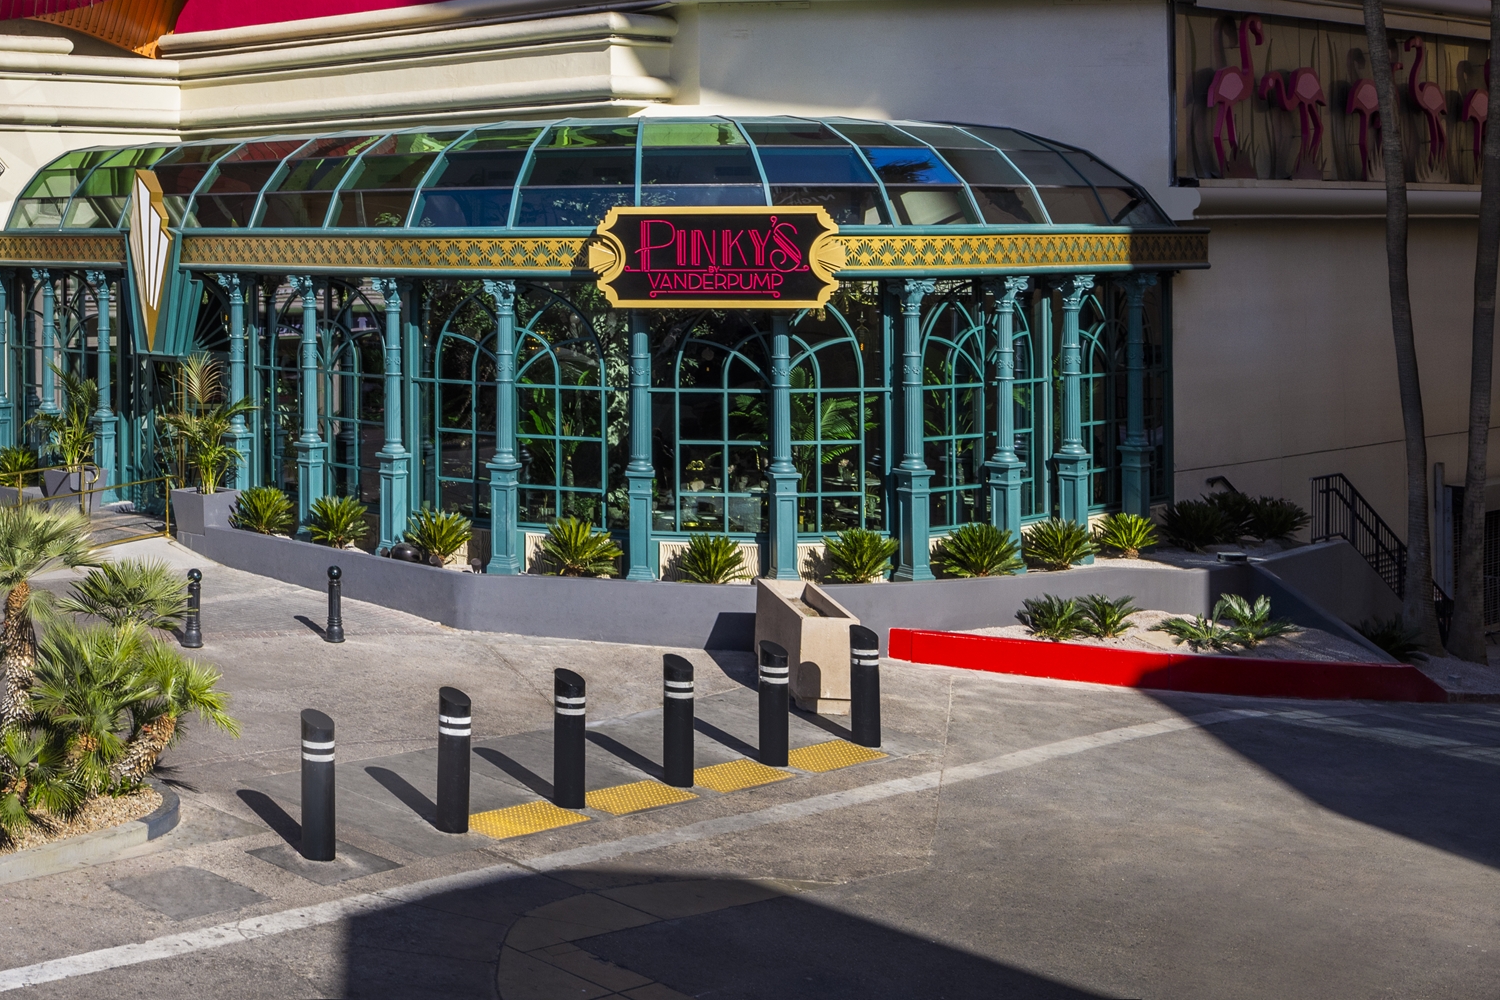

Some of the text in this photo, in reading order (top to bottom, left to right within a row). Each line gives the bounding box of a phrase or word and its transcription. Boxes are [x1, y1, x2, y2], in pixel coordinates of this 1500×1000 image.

[634, 215, 802, 273] PINKY'S
[708, 265, 720, 274] BY
[647, 273, 784, 290] VANDERPUMP
